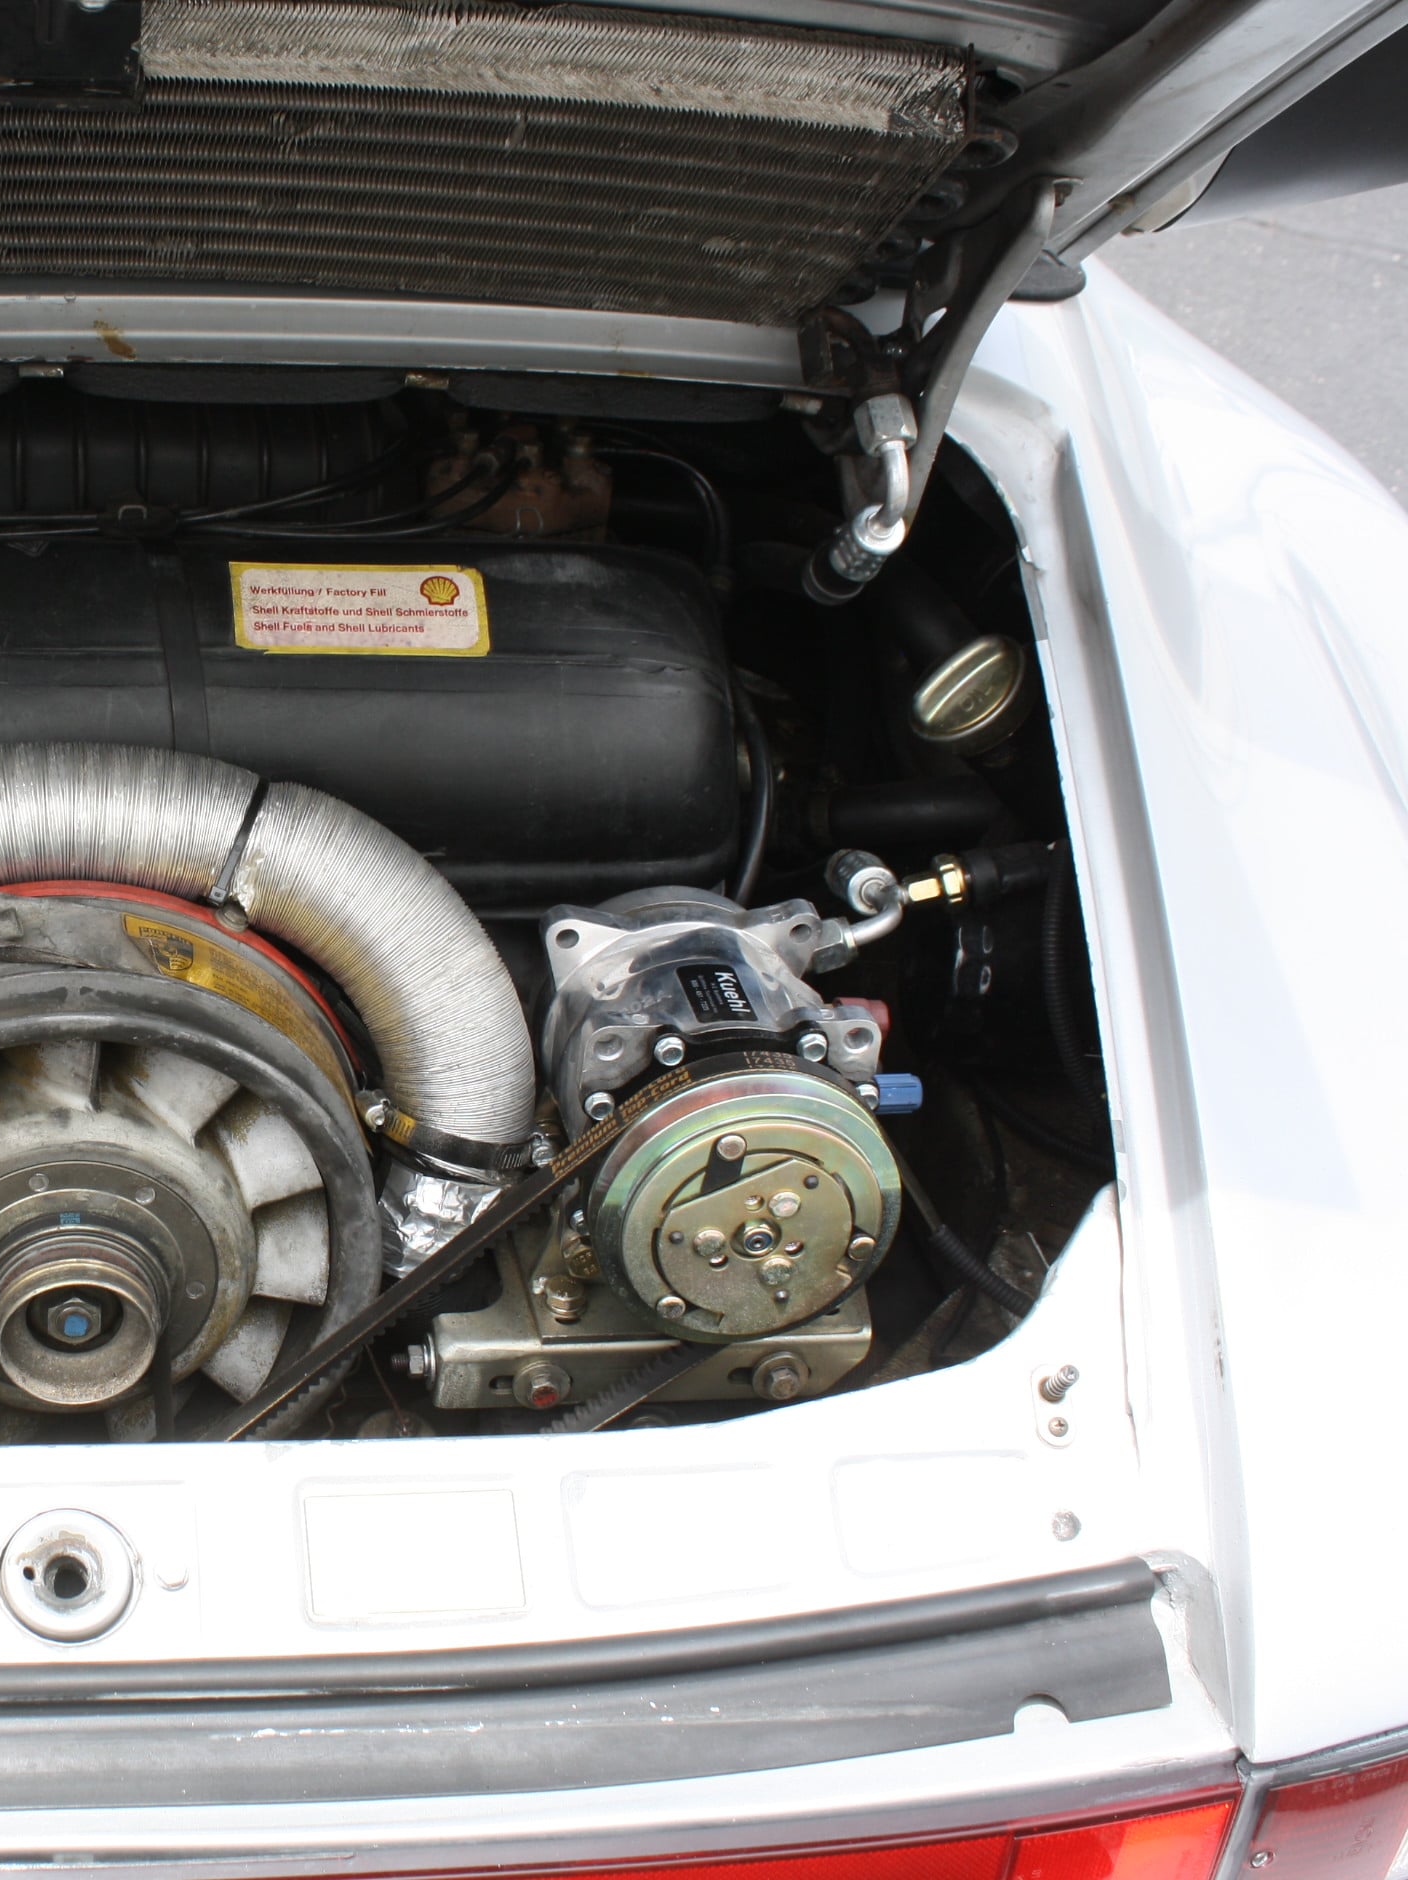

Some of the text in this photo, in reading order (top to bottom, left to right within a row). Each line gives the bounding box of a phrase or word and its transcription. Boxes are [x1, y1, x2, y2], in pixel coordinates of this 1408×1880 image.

[249, 586, 315, 597] Werkfüllung
[326, 587, 367, 598] Factory
[370, 588, 386, 597] Fill
[252, 605, 469, 617] Shell Kraftstoffe und Shell Schmierstoffe
[253, 621, 425, 633] Shell Fuels and Shell Lubricants
[714, 971, 751, 1013] Kuehl
[551, 1119, 618, 1175] Premium
